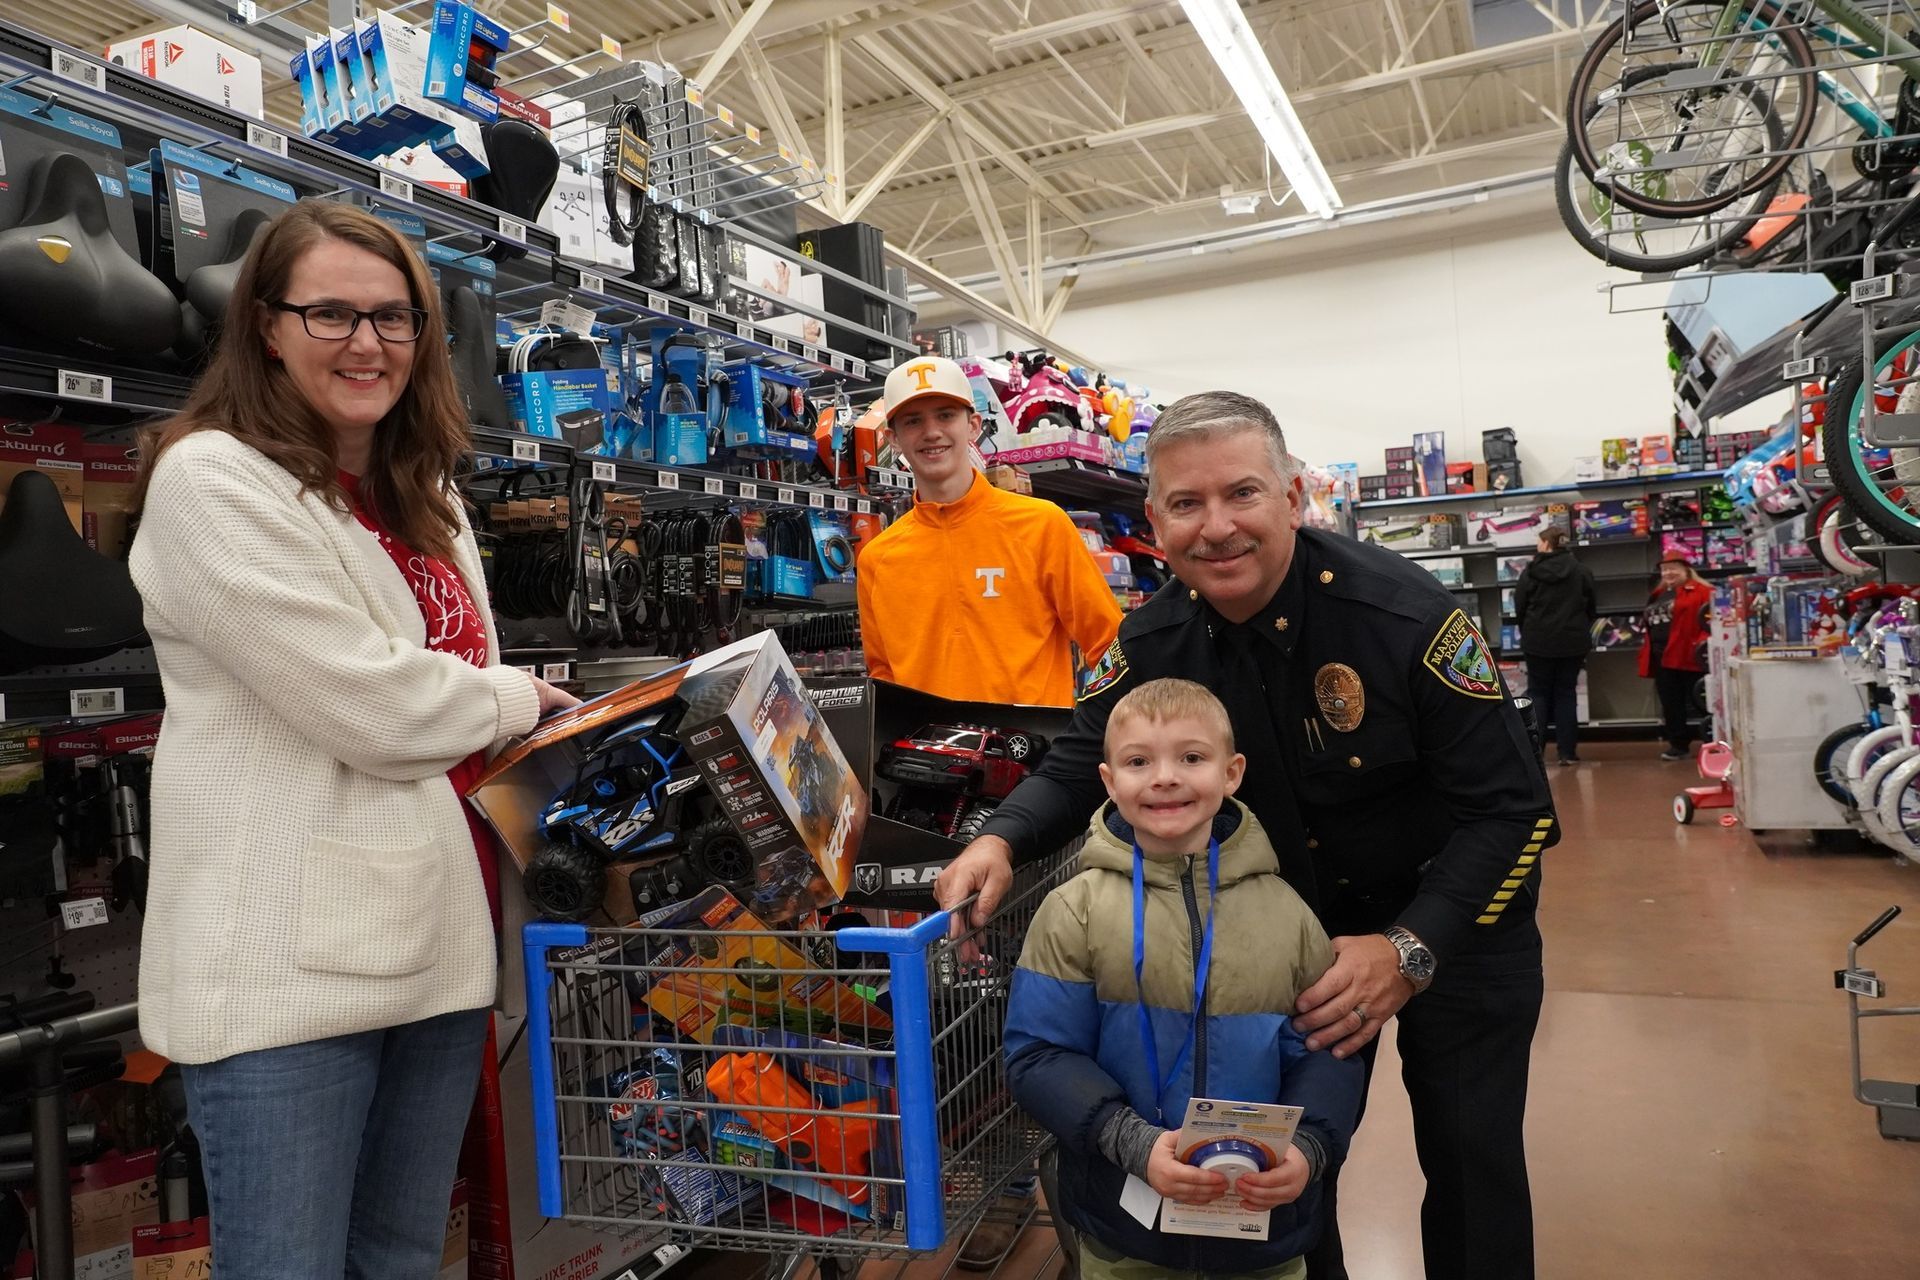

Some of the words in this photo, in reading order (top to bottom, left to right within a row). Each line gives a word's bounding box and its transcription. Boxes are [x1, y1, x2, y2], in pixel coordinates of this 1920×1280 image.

[458, 12, 469, 59] CONCORD
[69, 116, 90, 130] Selle
[254, 176, 271, 188] Selle
[553, 383, 580, 391] Handlebar
[581, 382, 598, 390] Basket
[907, 363, 937, 390] T
[531, 380, 546, 436] ONCORD
[975, 567, 1005, 598] T
[1431, 615, 1466, 665] MARYVILLE
[1444, 626, 1469, 660] POLICE
[753, 681, 780, 733] POLARIS
[821, 696, 858, 707] FORCE
[643, 910, 670, 925] RADIO
[558, 936, 616, 961] POLARIS
[568, 1243, 603, 1270] TRUNK
